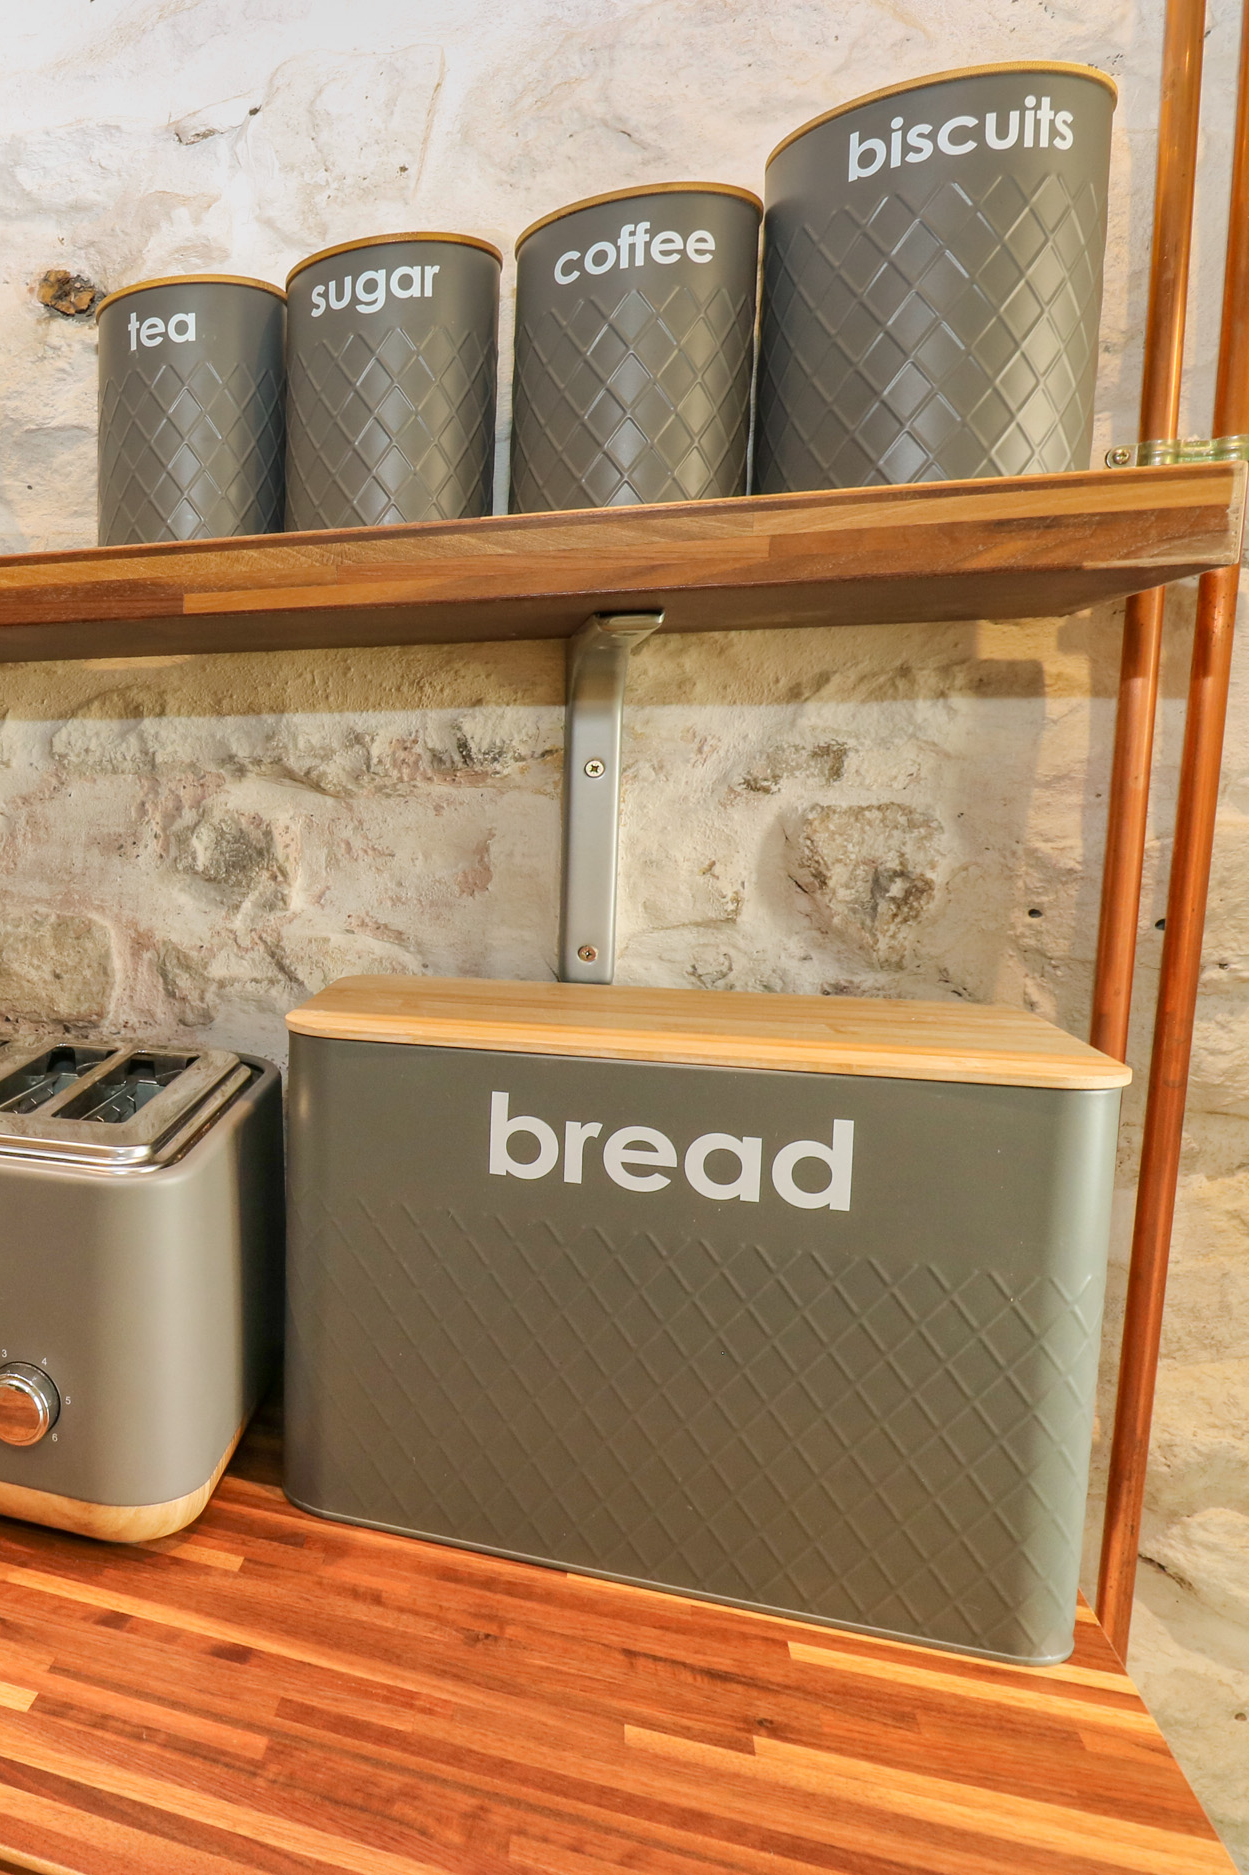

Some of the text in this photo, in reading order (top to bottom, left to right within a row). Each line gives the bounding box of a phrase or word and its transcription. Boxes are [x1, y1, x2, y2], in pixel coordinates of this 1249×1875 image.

[847, 95, 1075, 184] biscuits
[553, 221, 717, 286] coffee
[310, 264, 442, 319] sugar
[127, 312, 197, 352] tea
[488, 1091, 856, 1213] bread
[1, 1349, 8, 1358] 3
[41, 1357, 47, 1366] 4
[65, 1396, 72, 1405] 5
[51, 1433, 58, 1442] 6
